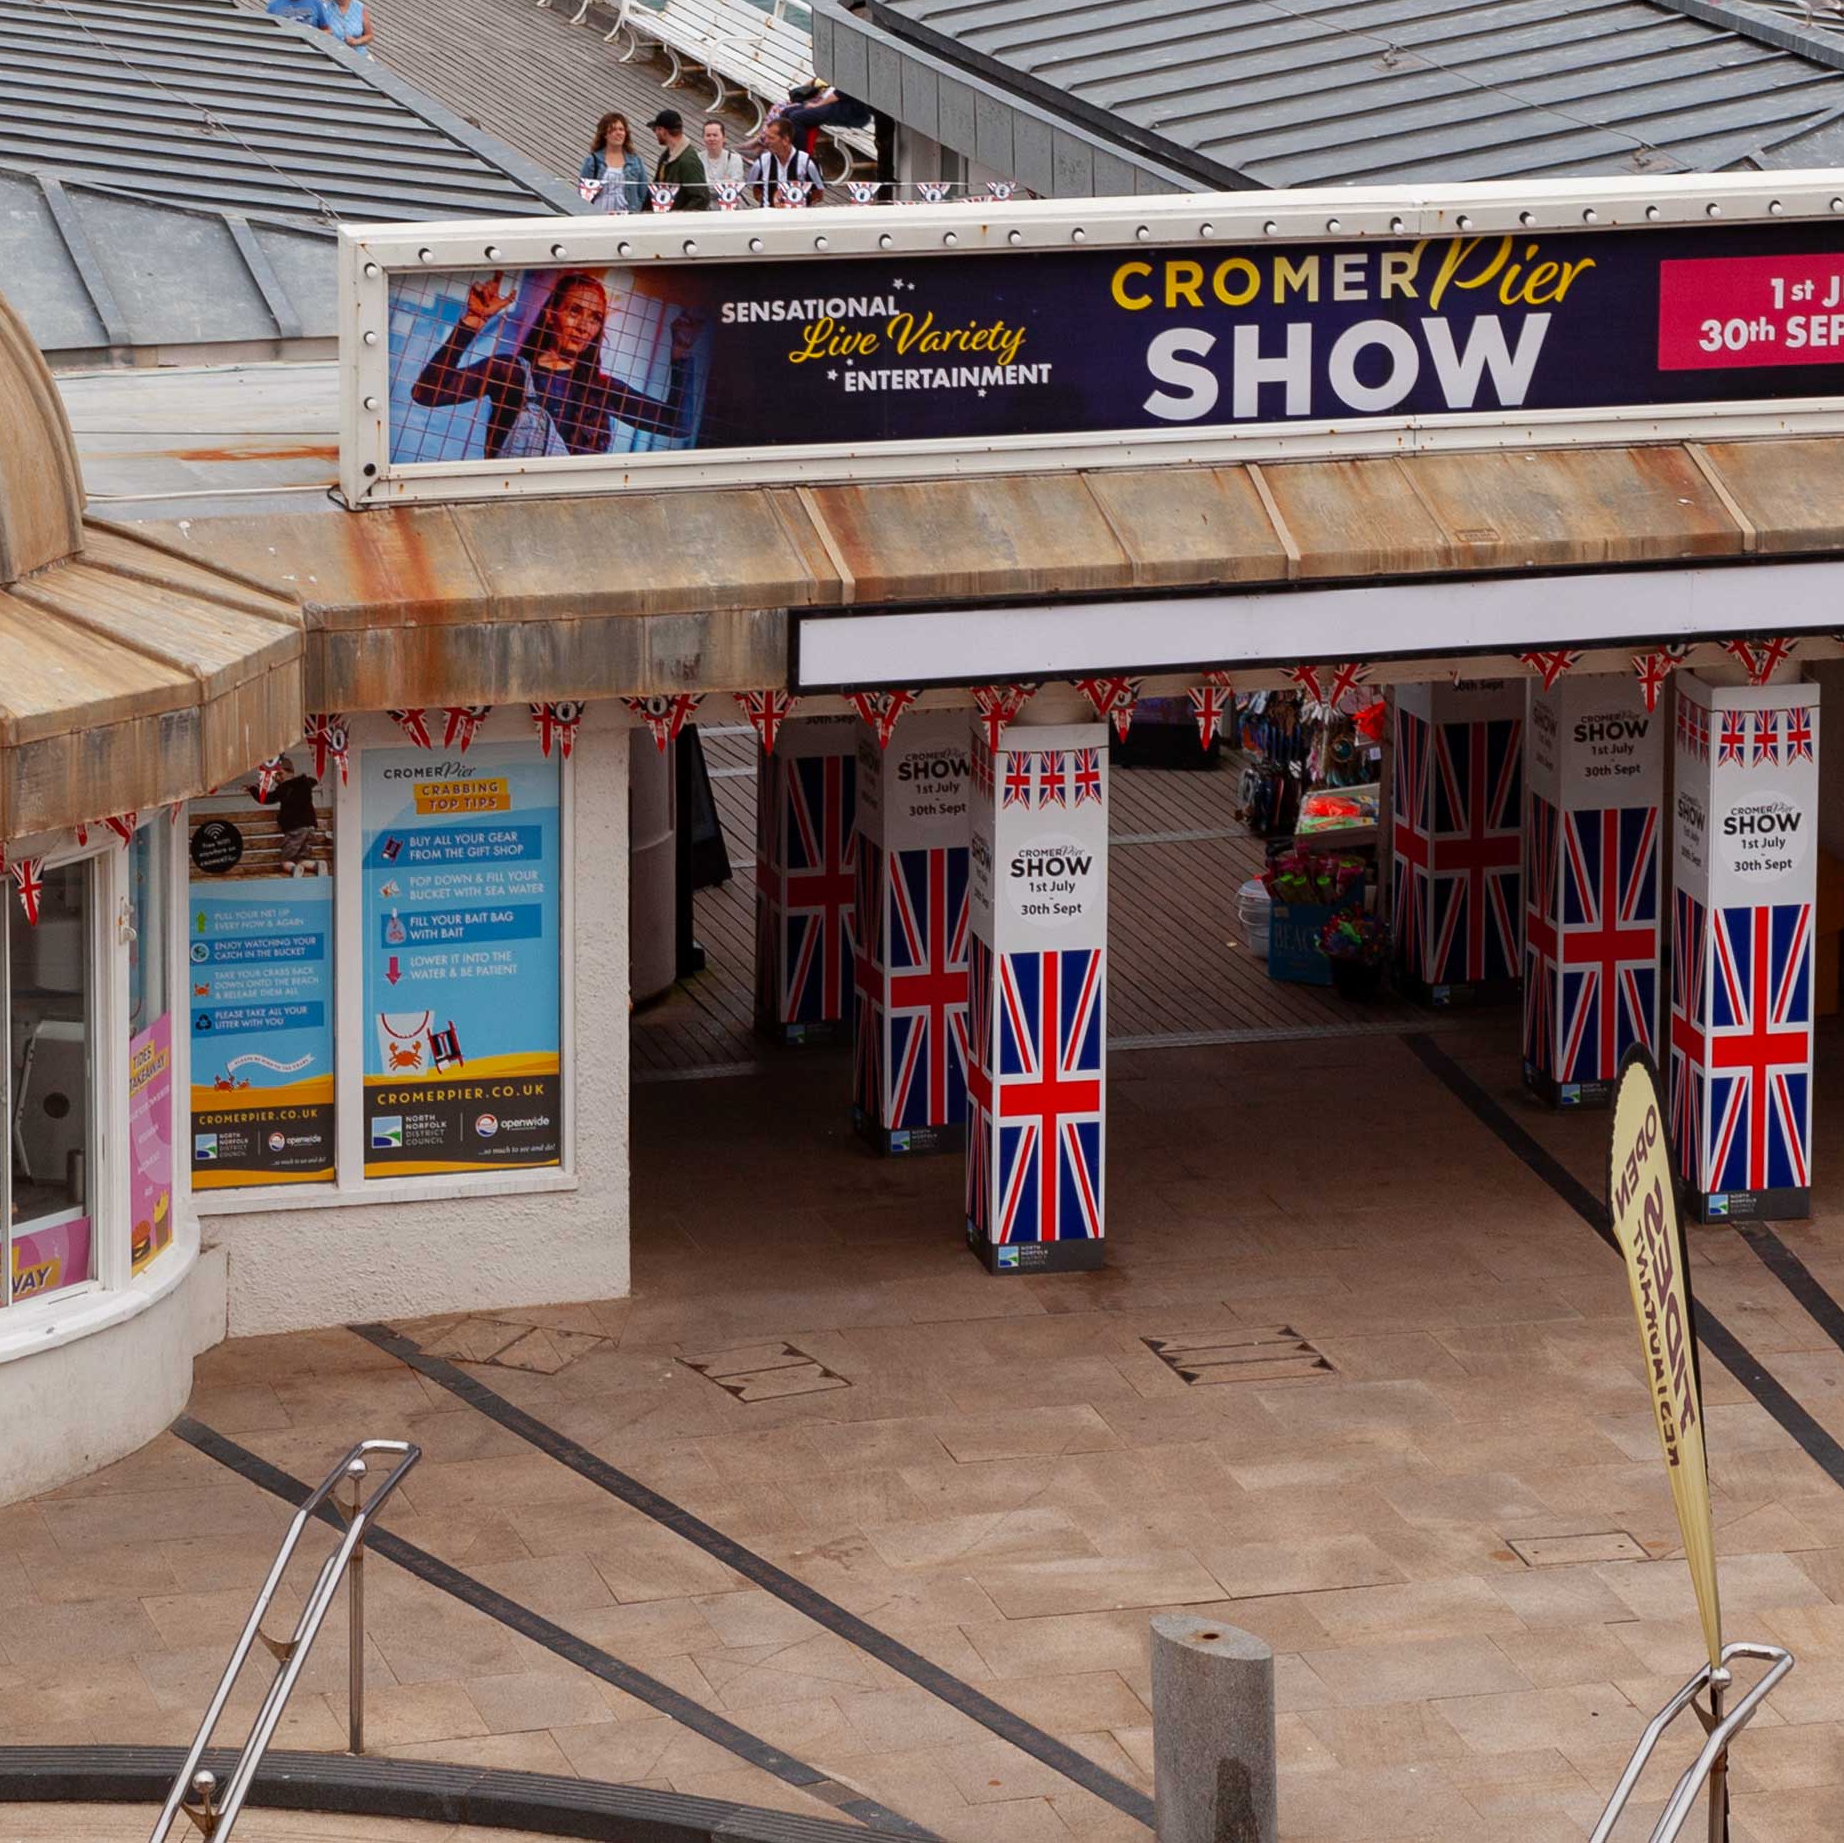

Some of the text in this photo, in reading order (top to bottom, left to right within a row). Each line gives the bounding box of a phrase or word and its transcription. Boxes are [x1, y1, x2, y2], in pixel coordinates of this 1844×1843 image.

[1111, 252, 1419, 310] CROMER
[1770, 277, 1815, 309] 1st
[721, 296, 900, 323] SENSATIONAL
[789, 311, 1026, 366] Live Variety
[1699, 316, 1775, 352] 30th
[1143, 312, 1553, 421] SHOW
[844, 363, 1052, 392] ENTERTAINMENT
[1573, 719, 1649, 743] SHOW
[1591, 742, 1635, 756] 1st July
[383, 761, 476, 779] CROMER Pier
[1584, 763, 1641, 777] 30th Sept
[422, 782, 499, 796] CRABBING
[915, 781, 960, 794] 1st July
[428, 797, 497, 810] TOP TIPS
[909, 802, 967, 817] 30th Sept
[1723, 812, 1802, 835] SHOW
[409, 831, 518, 847] BUY ALL YOUR GEAR
[1741, 837, 1786, 850] 1st July
[409, 844, 524, 860] FROM THE GIFT SHOP
[1010, 856, 1093, 877] SHOW
[1734, 859, 1792, 872] 30th Sept
[409, 870, 538, 887] POP DOWN FILL YOUR
[1029, 880, 1076, 893] 1st July
[409, 883, 545, 900] BUCKET WITH SEA WATER
[1021, 903, 1082, 917] 30th Sept
[410, 911, 514, 927] FILL YOUR BAIT BAG
[410, 927, 464, 940] WITH BAIT
[215, 936, 317, 950] ENJOY WATCHING YOUR
[214, 947, 305, 960] CATCH BUCKET
[411, 951, 511, 967] LOWER INTO THE
[411, 964, 517, 979] WATER BE PATIENT
[215, 1010, 244, 1019] PLEASE
[215, 1020, 240, 1029] LITTER
[133, 1045, 152, 1067] TIDES
[377, 1084, 545, 1105] CROMERPIER.CO.UK
[199, 1109, 318, 1125] CROMERPIER.CO.UK
[406, 1114, 436, 1123] NORTH
[501, 1115, 550, 1132] openwide
[406, 1121, 447, 1130] NORFOLK
[406, 1128, 445, 1137] DISTRICT
[406, 1137, 444, 1146] COUNCIL
